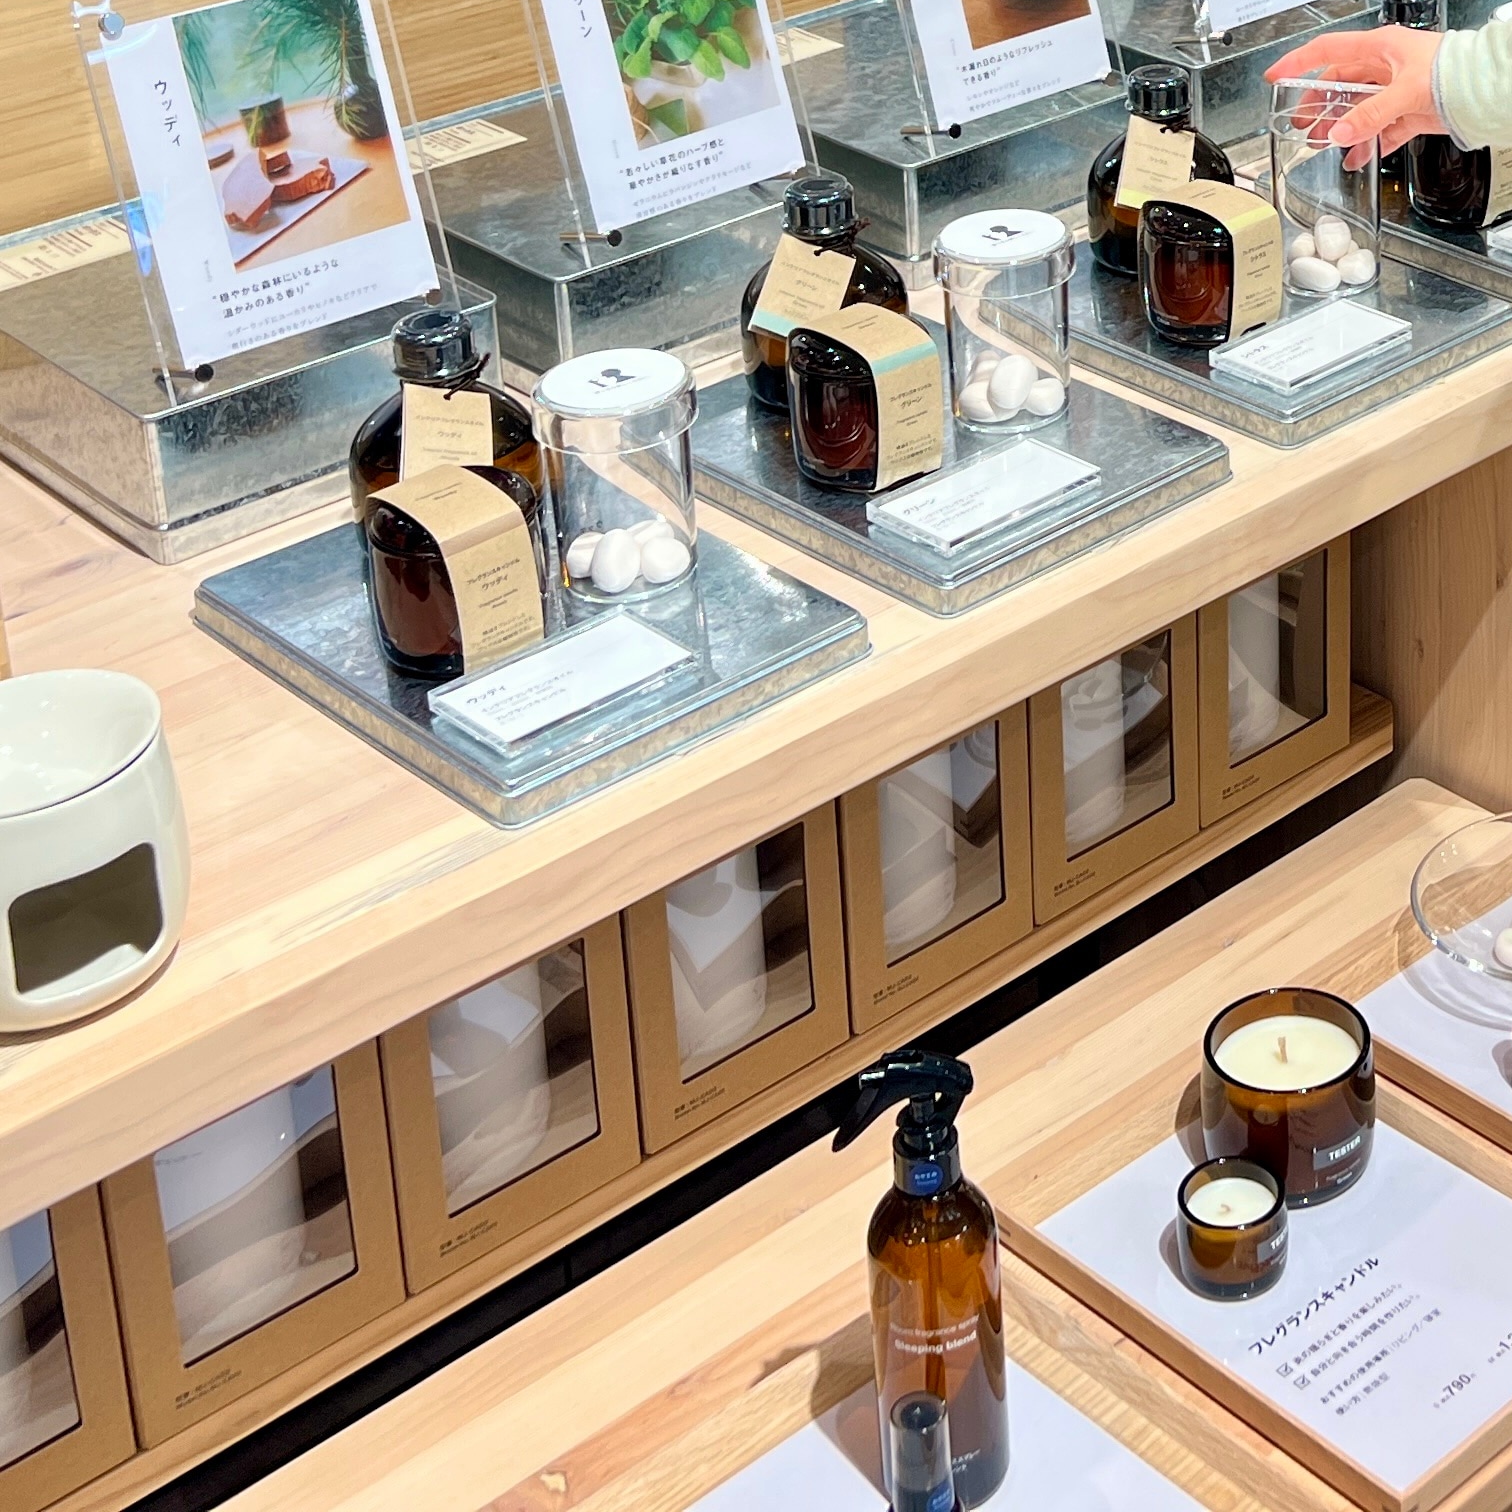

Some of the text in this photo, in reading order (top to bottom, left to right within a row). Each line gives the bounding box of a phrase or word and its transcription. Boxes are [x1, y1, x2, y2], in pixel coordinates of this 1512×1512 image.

[154, 79, 182, 148] ウッディ
[1328, 1134, 1362, 1162] TESTER
[1247, 1254, 1381, 1357] フレグランスキャンドル
[915, 1325, 957, 1338] fragrance
[957, 1313, 980, 1330] spray
[894, 1329, 977, 1355] Sleeping blend
